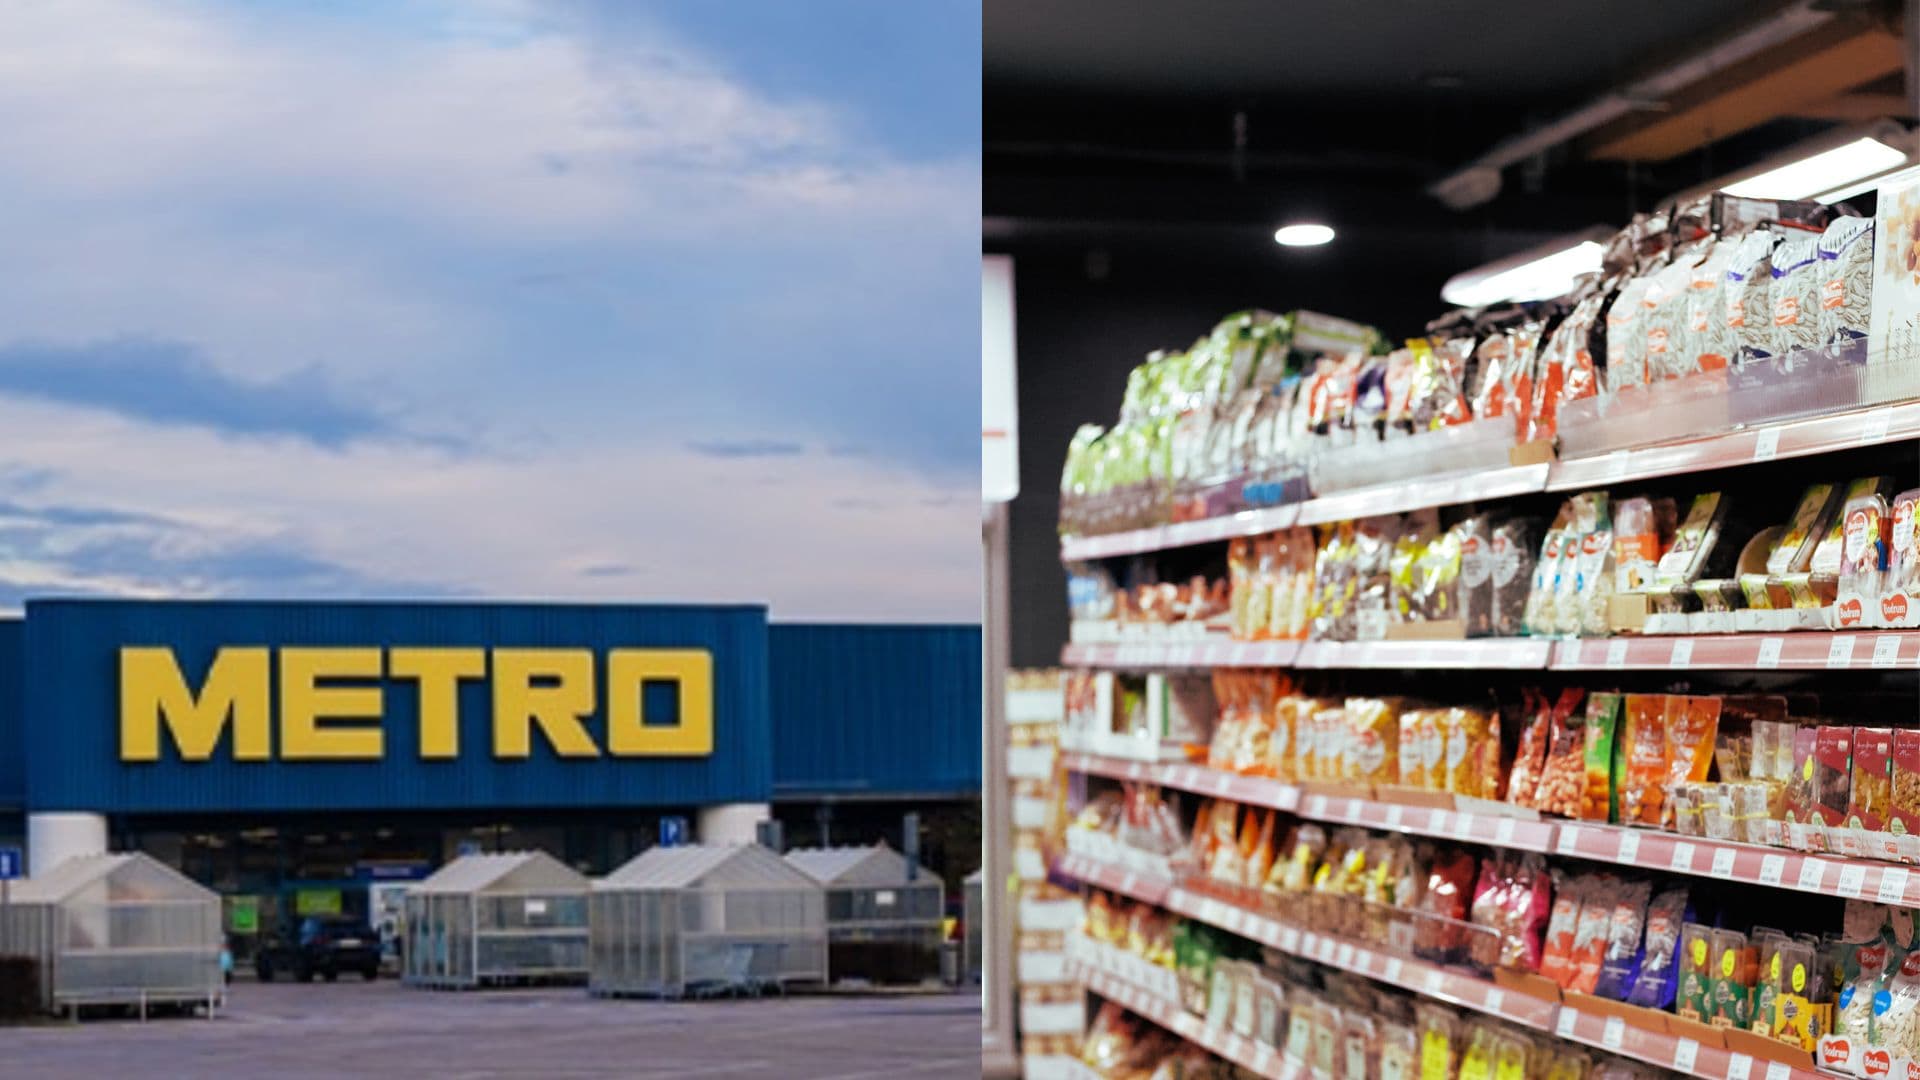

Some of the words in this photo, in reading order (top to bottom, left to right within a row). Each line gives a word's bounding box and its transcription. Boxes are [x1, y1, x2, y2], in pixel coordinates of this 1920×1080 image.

[120, 646, 714, 761] METRO
[1824, 1044, 1848, 1058] Bodrum
[1866, 1055, 1889, 1071] Bodrum
